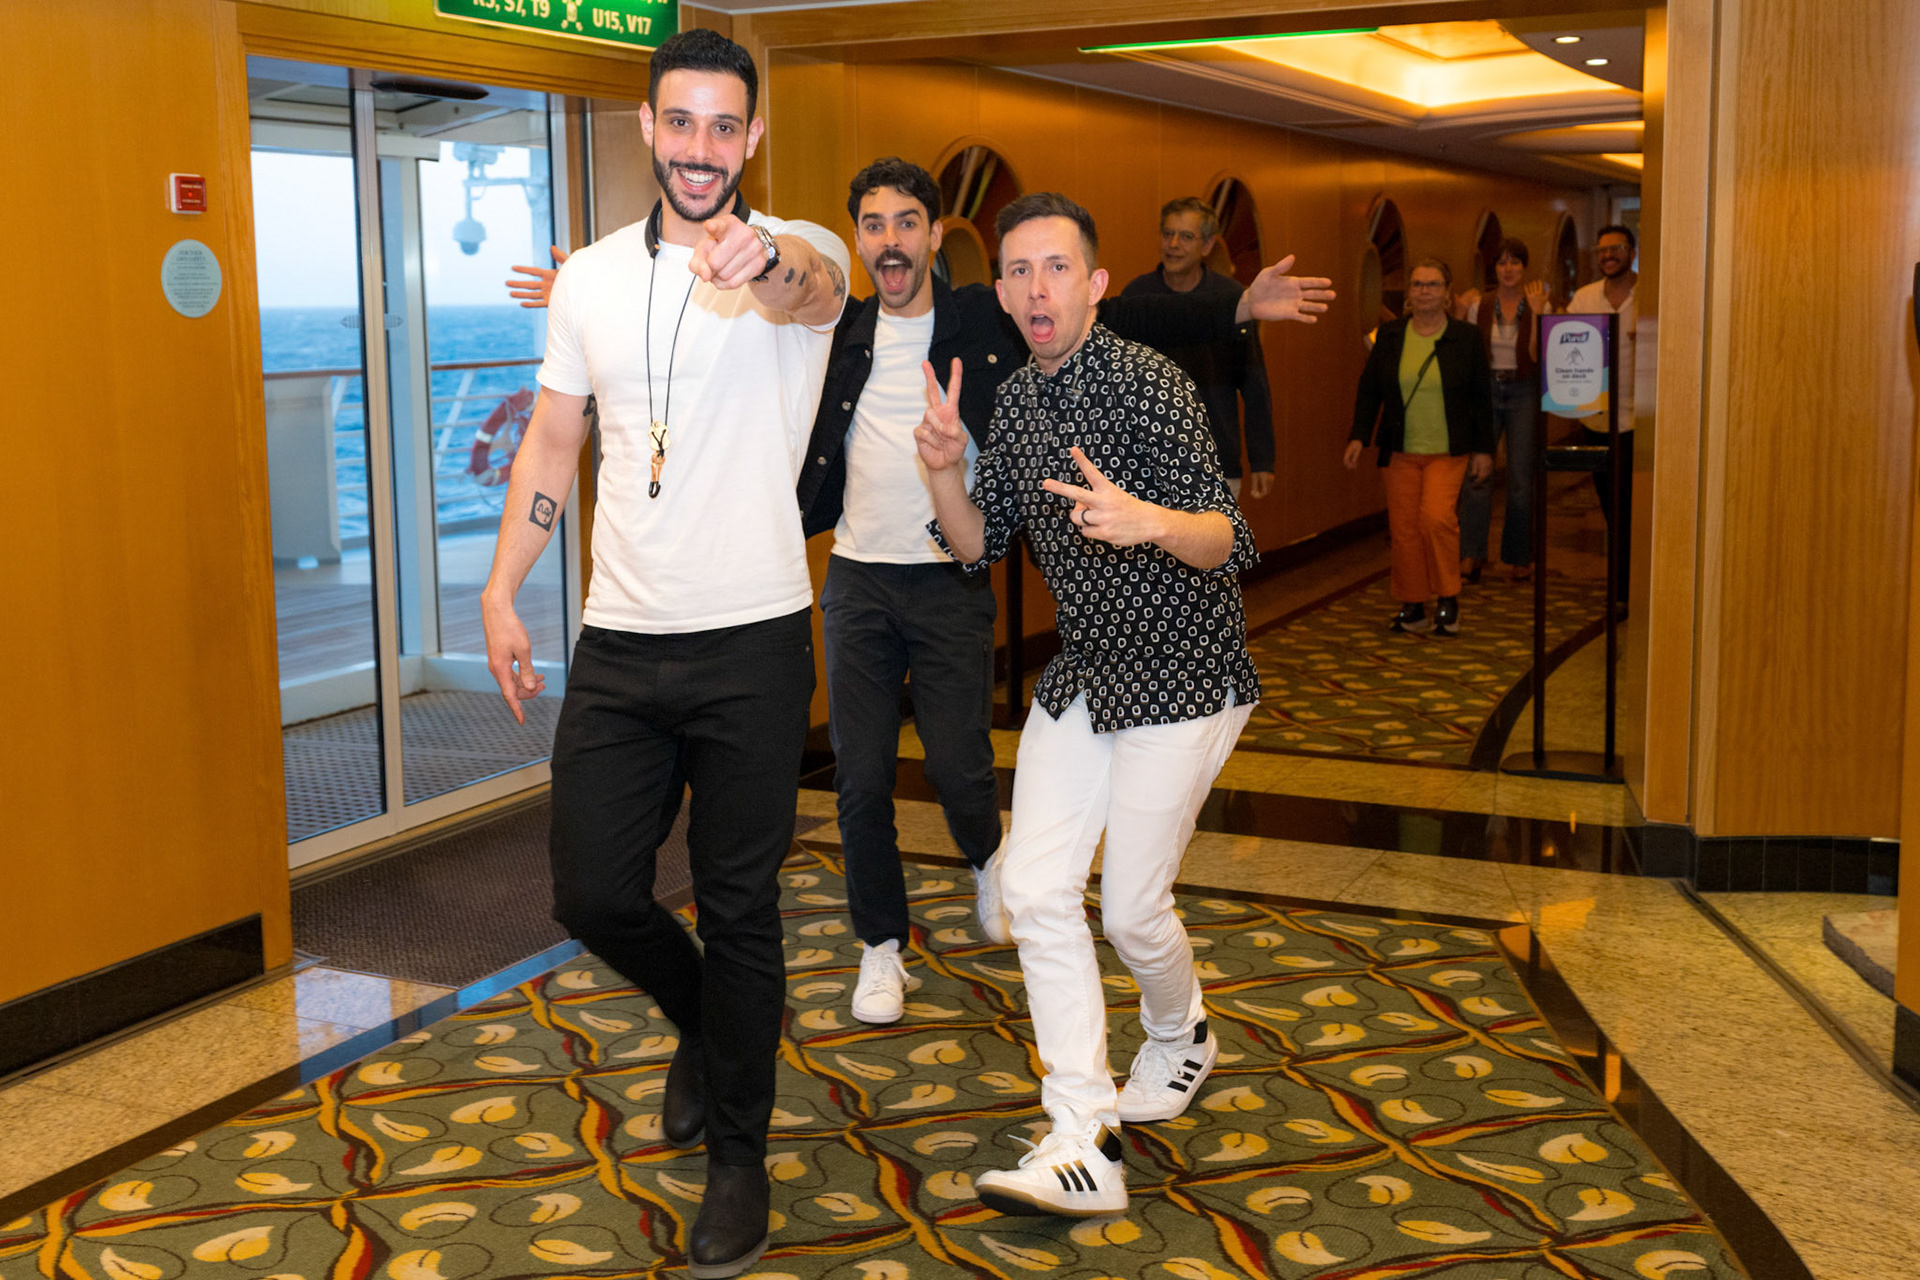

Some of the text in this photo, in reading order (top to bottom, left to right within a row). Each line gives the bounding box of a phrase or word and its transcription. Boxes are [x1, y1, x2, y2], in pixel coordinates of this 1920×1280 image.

[531, 0, 551, 19] T9
[592, 7, 652, 35] U15, V17
